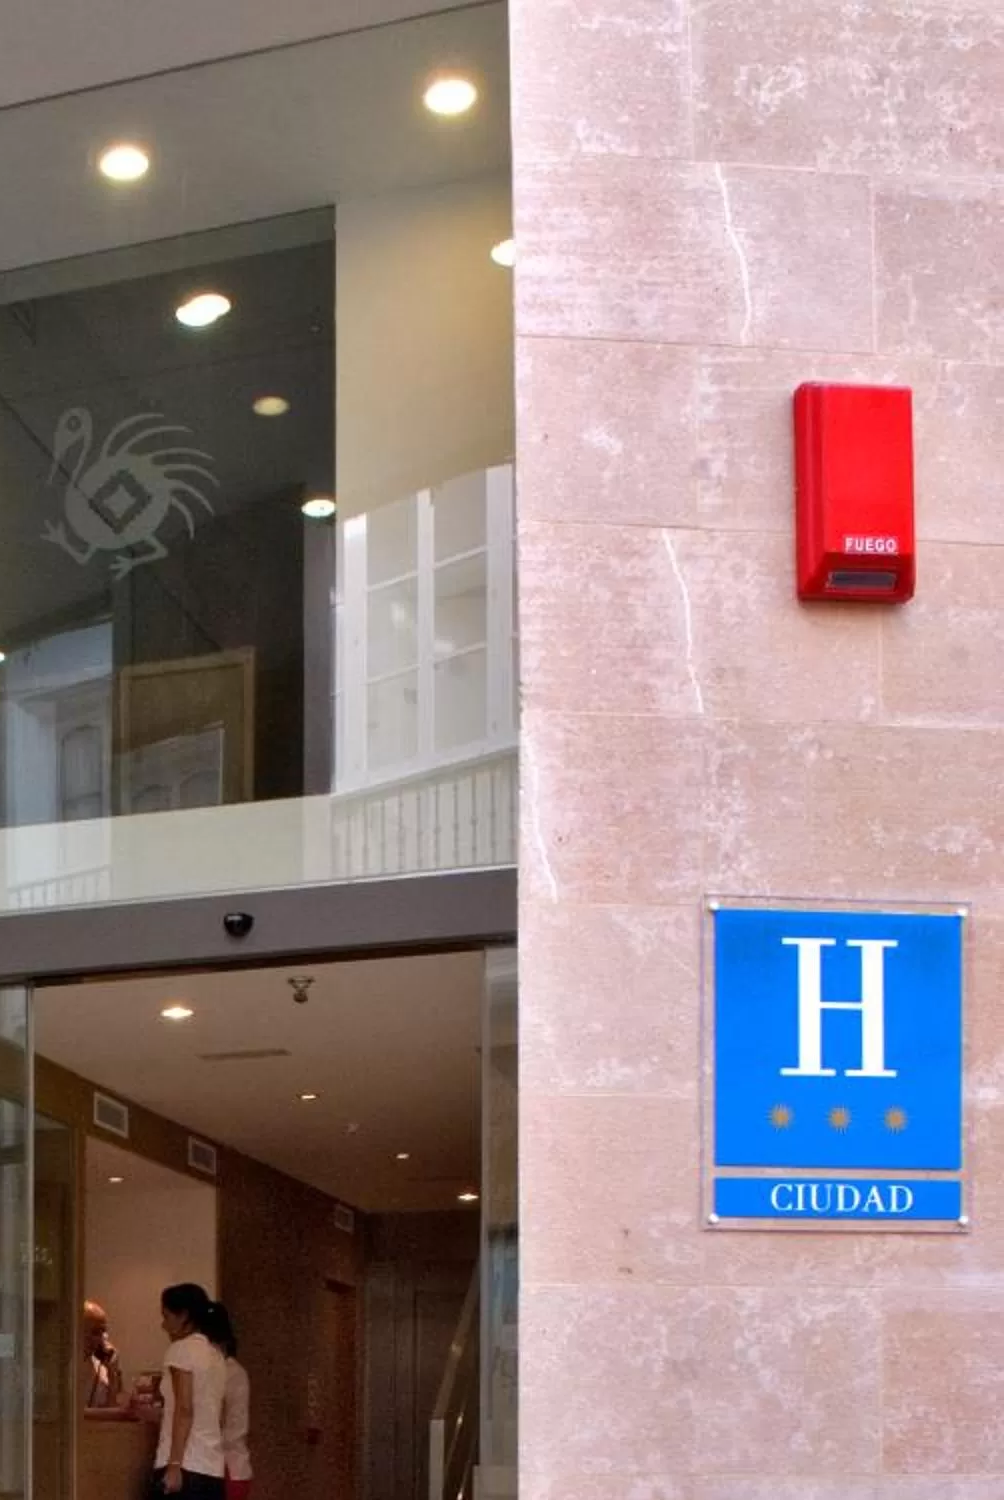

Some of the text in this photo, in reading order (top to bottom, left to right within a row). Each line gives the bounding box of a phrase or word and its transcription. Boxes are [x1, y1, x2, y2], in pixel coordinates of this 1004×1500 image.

[844, 537, 898, 553] FUEGO
[780, 937, 899, 1078] H
[770, 1183, 914, 1213] CIUDAD
